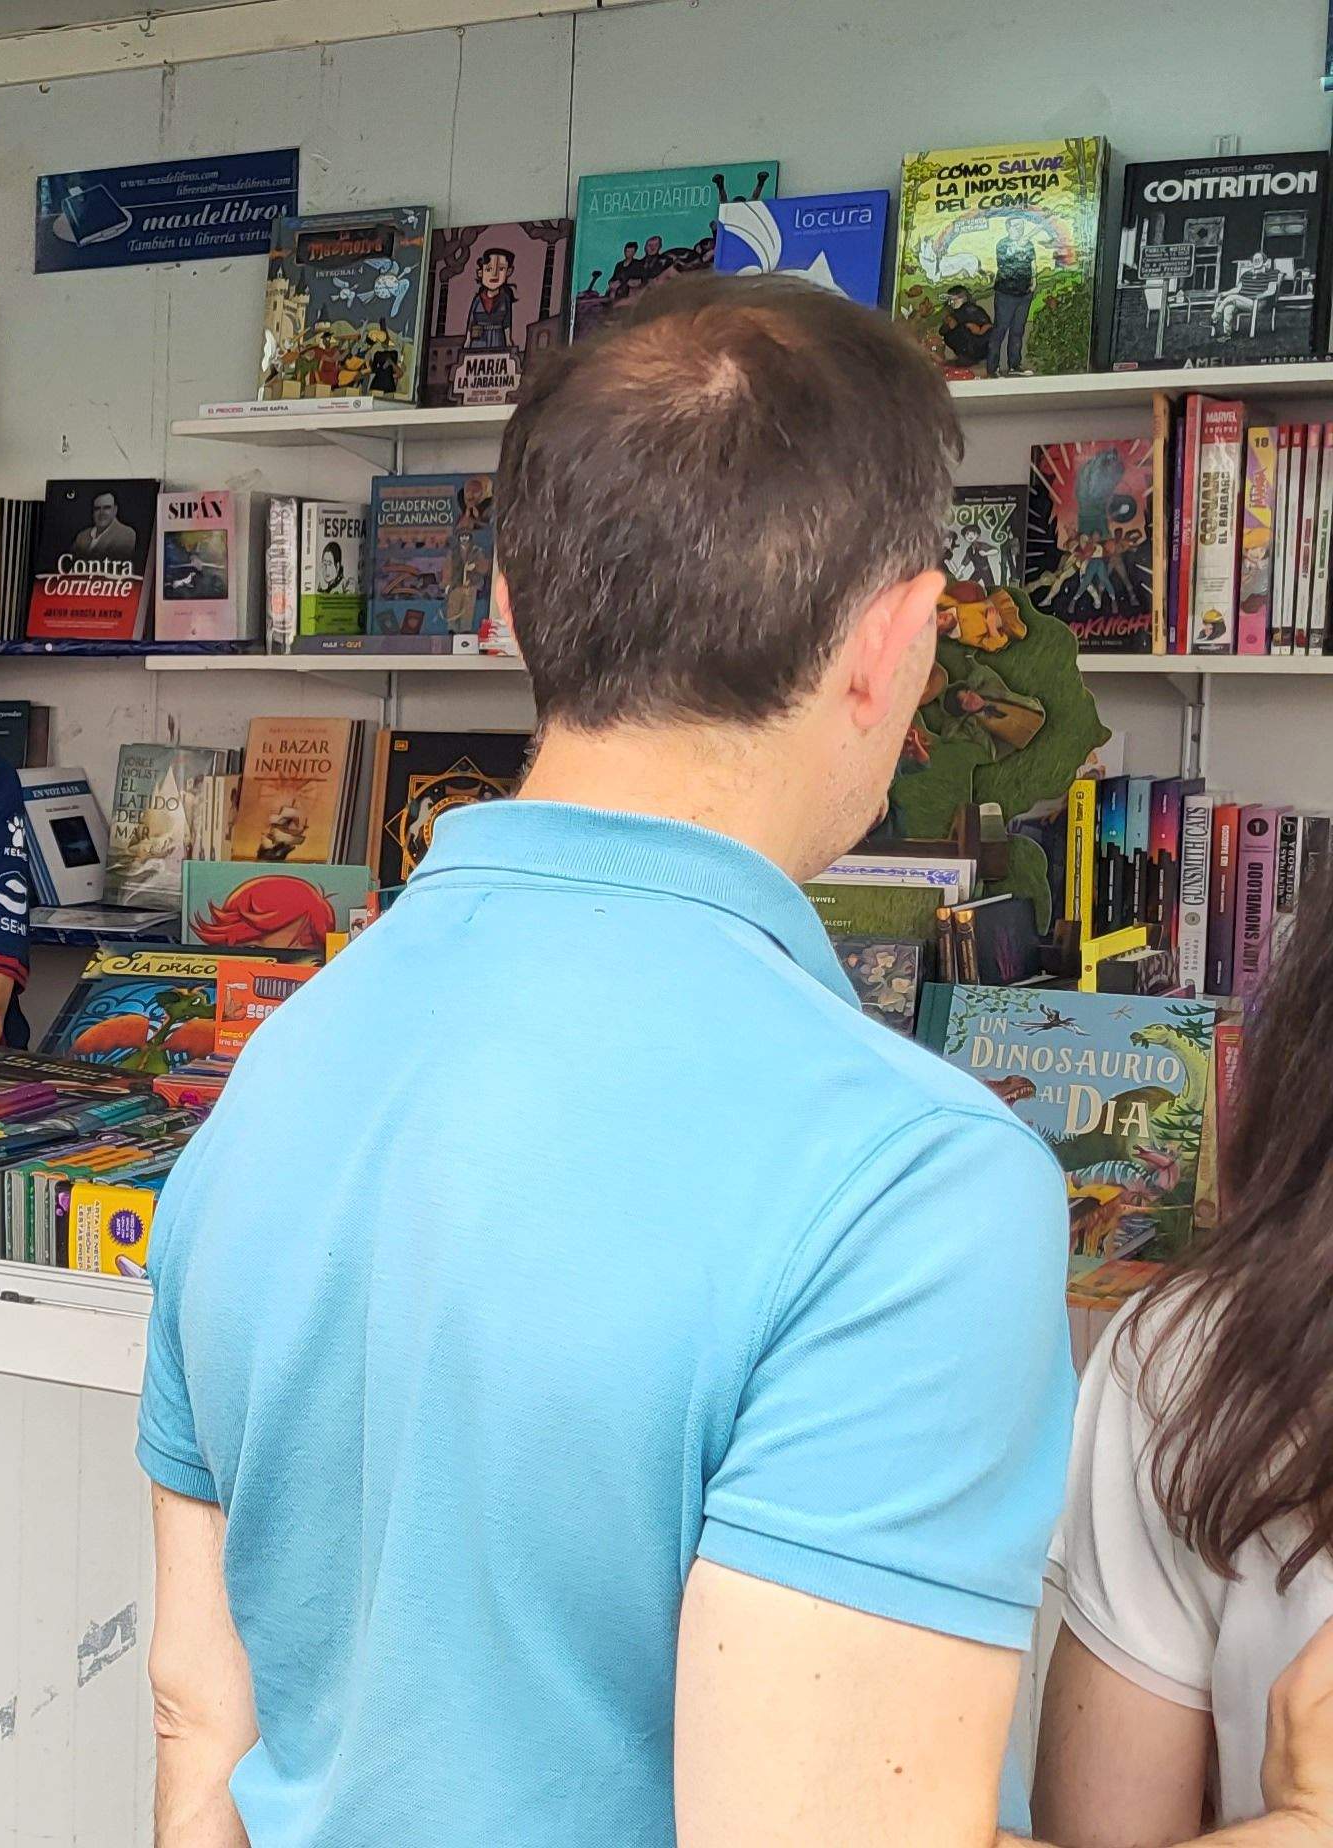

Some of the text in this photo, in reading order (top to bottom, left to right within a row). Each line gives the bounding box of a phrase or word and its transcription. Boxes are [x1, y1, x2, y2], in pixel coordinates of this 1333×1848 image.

[998, 156, 1065, 175] SALVAR
[935, 174, 1060, 198] LA INDUSTRIA
[1144, 171, 1318, 203] CONTRITION
[935, 198, 970, 213] DEL
[142, 200, 289, 232] masdelibros
[795, 208, 872, 229] locura
[179, 236, 191, 248] tu
[239, 229, 274, 244] virtu
[458, 376, 515, 389] LA JABALINA
[1205, 411, 1237, 423] MARVEL
[168, 493, 223, 520] SIPÁN
[381, 499, 451, 512] CUADERNOS
[1199, 472, 1220, 546] CONAN
[324, 517, 367, 539] ESPERA
[377, 511, 454, 525] UCRANIANOS
[57, 553, 133, 577] Contra
[44, 574, 133, 598] Corriente
[279, 740, 330, 754] BAZAR
[255, 758, 332, 774] INFINITO
[120, 779, 137, 792] EL
[119, 793, 180, 812] LATIDO
[115, 825, 150, 841] MAR
[1183, 806, 1209, 906] GUNSMITH CATS
[1244, 862, 1264, 940] SNOWBLOOD
[979, 1016, 1010, 1036] UN
[970, 1036, 1182, 1085] DINOSAURIO
[1036, 1085, 1066, 1105] AL
